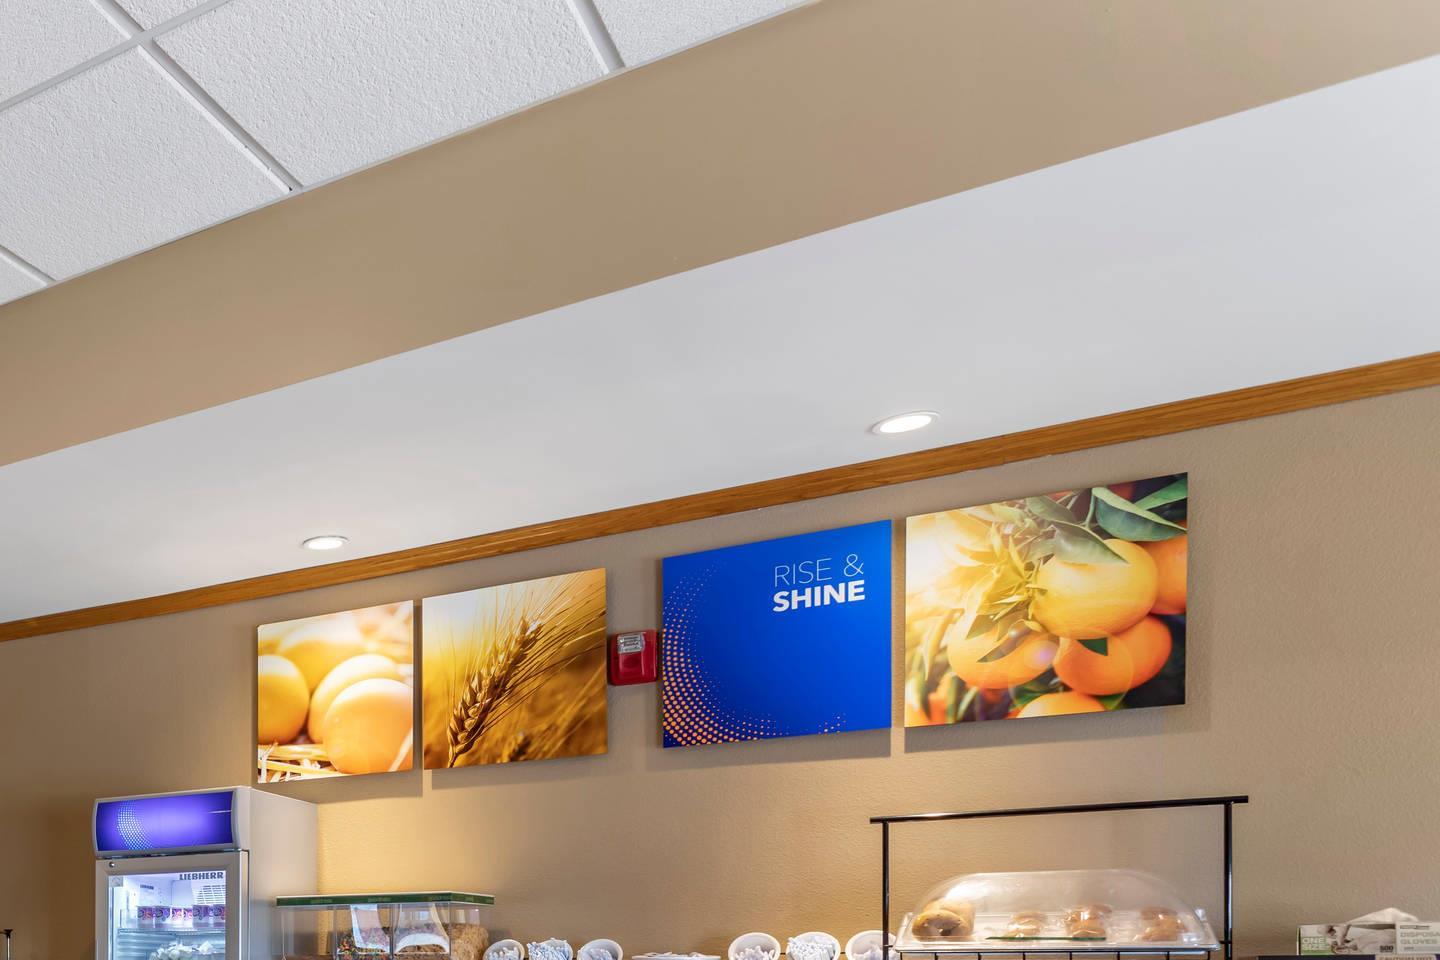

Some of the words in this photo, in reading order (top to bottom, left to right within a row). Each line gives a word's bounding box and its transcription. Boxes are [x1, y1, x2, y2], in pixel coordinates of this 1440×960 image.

[774, 557, 832, 587] RISE
[843, 553, 864, 577] &
[772, 580, 865, 612] SHINE
[179, 871, 224, 881] LIEBHERR
[1302, 937, 1326, 945] ONE
[1379, 945, 1394, 953] 500
